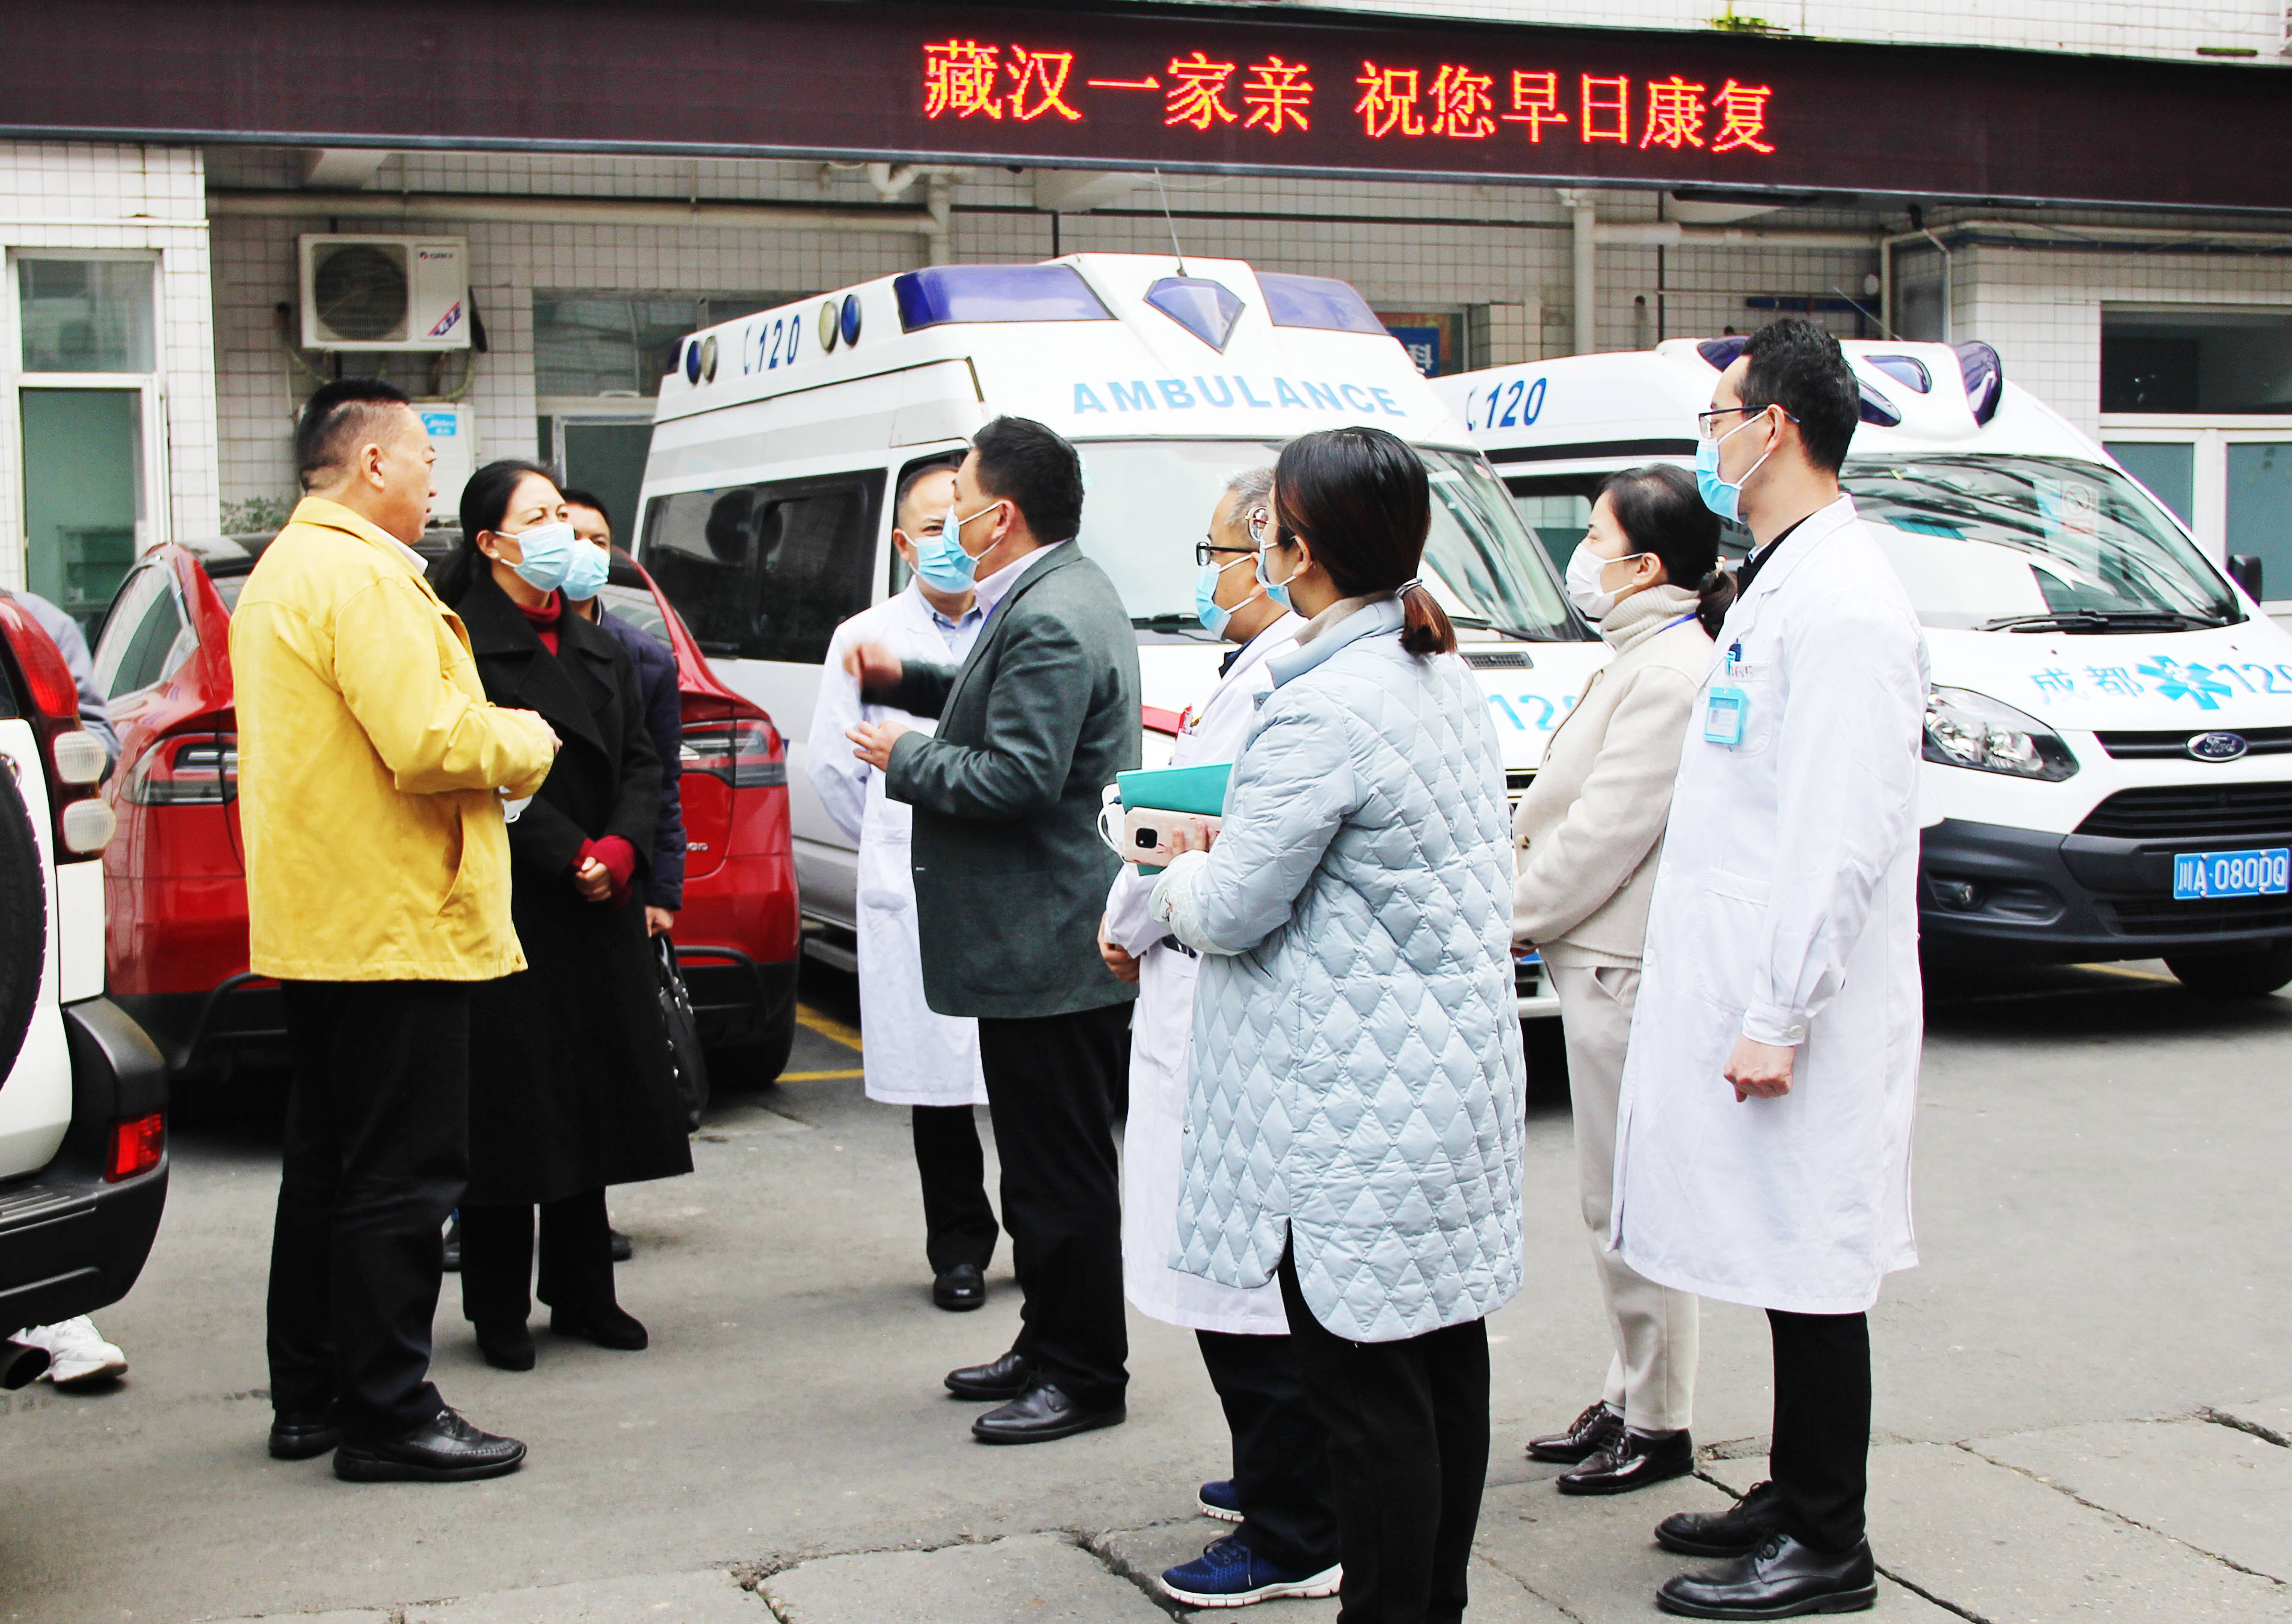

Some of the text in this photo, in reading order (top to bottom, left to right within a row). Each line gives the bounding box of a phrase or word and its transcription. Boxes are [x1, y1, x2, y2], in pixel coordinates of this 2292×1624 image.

[923, 38, 1776, 154] 藏汉一家亲 祝您早日康复
[758, 314, 801, 372] 120
[1074, 375, 1406, 416] AMBULANCE
[1486, 377, 1547, 428] 120
[1487, 694, 1579, 731] 12
